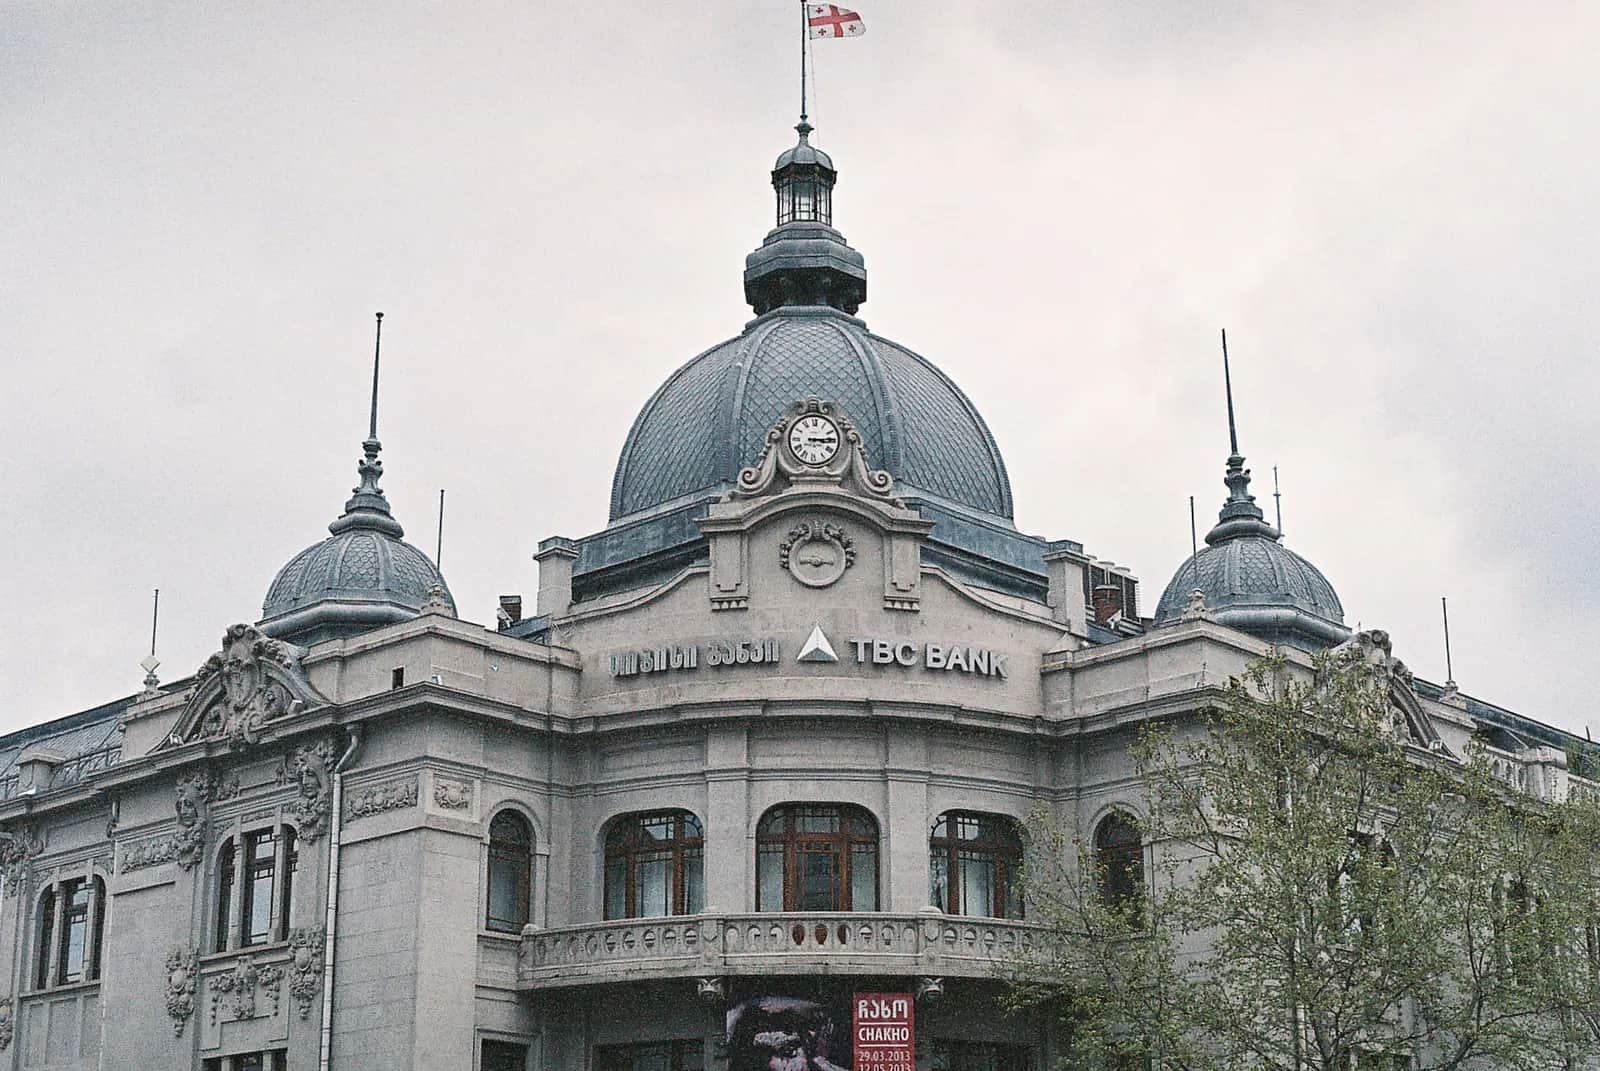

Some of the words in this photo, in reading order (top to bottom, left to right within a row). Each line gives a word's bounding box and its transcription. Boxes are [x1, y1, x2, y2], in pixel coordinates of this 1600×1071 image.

[706, 640, 779, 665] ბანკი
[850, 637, 918, 666] TBC
[926, 644, 1008, 680] BANK
[858, 999, 908, 1018] ჩახო
[858, 1027, 909, 1041] CHAKHO
[859, 1051, 910, 1061] 29.03.2013
